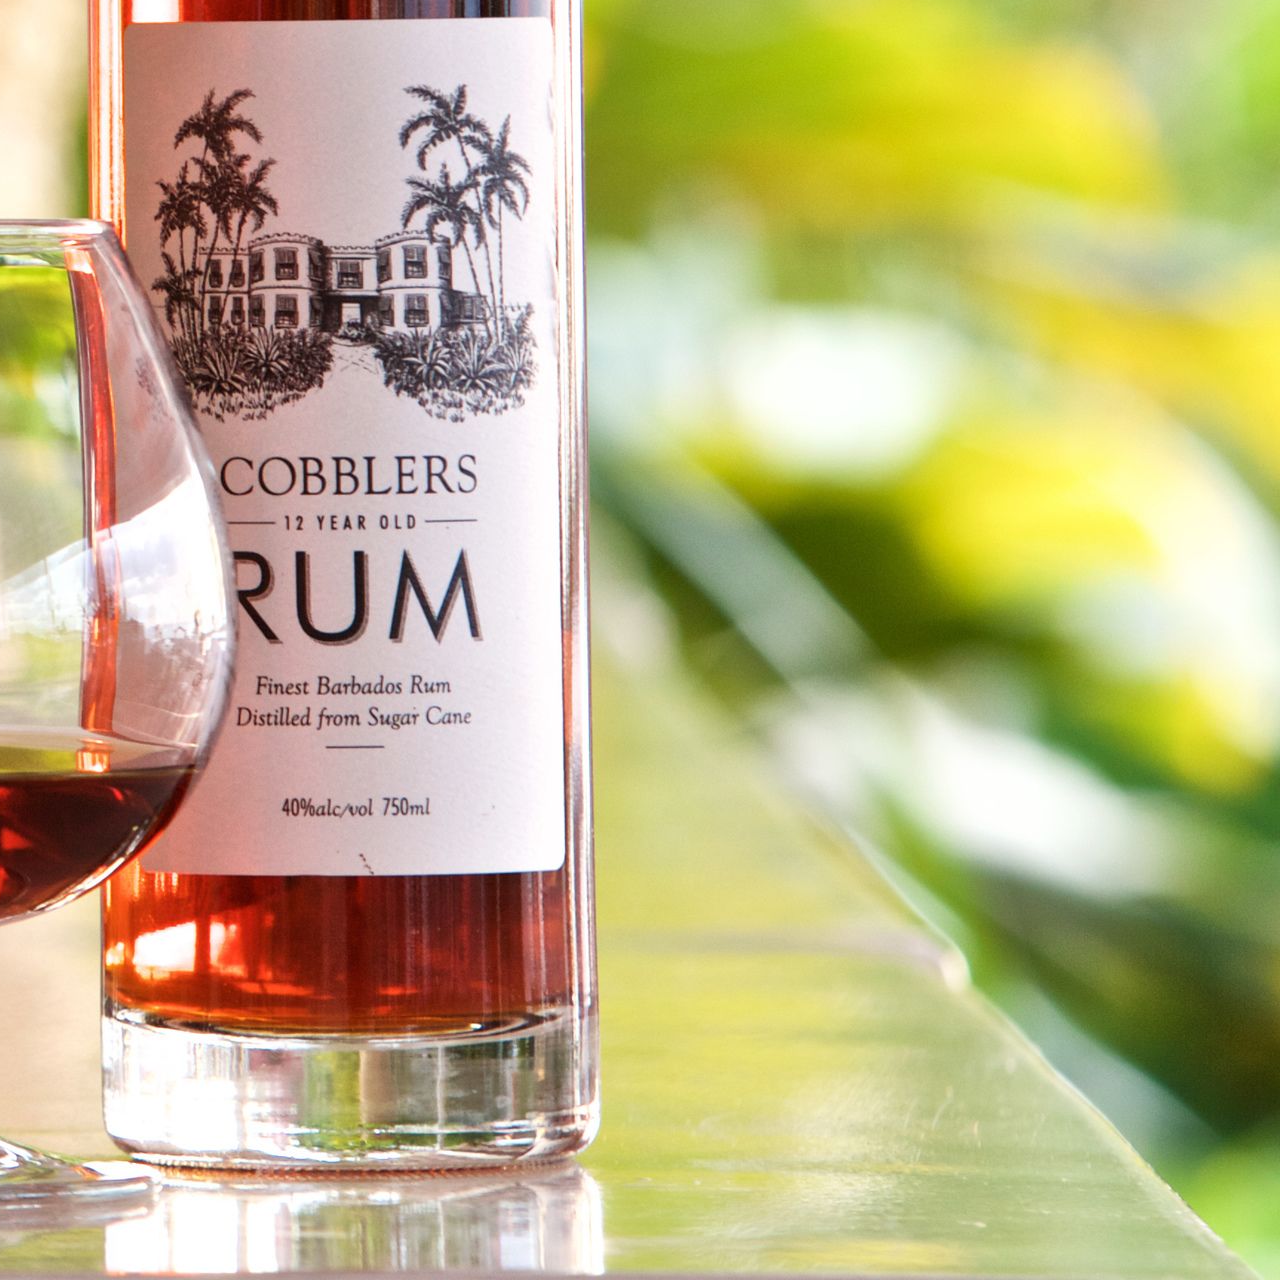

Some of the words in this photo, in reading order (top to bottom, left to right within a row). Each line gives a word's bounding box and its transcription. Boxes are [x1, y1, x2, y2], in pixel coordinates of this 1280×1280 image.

[220, 454, 478, 496] COBBLERS
[285, 516, 304, 531] 12
[317, 515, 367, 531] YEAR
[380, 514, 417, 530] OLD
[232, 548, 484, 646] RUM
[255, 675, 310, 696] Finest
[317, 675, 402, 696] Barbados
[410, 675, 452, 694] Rum
[237, 707, 311, 727] Distilled
[316, 707, 361, 730] from
[367, 707, 420, 730] Sugar
[425, 706, 472, 725] Cane
[281, 797, 374, 819] 40%alc/vol
[382, 797, 431, 817] 750ml
